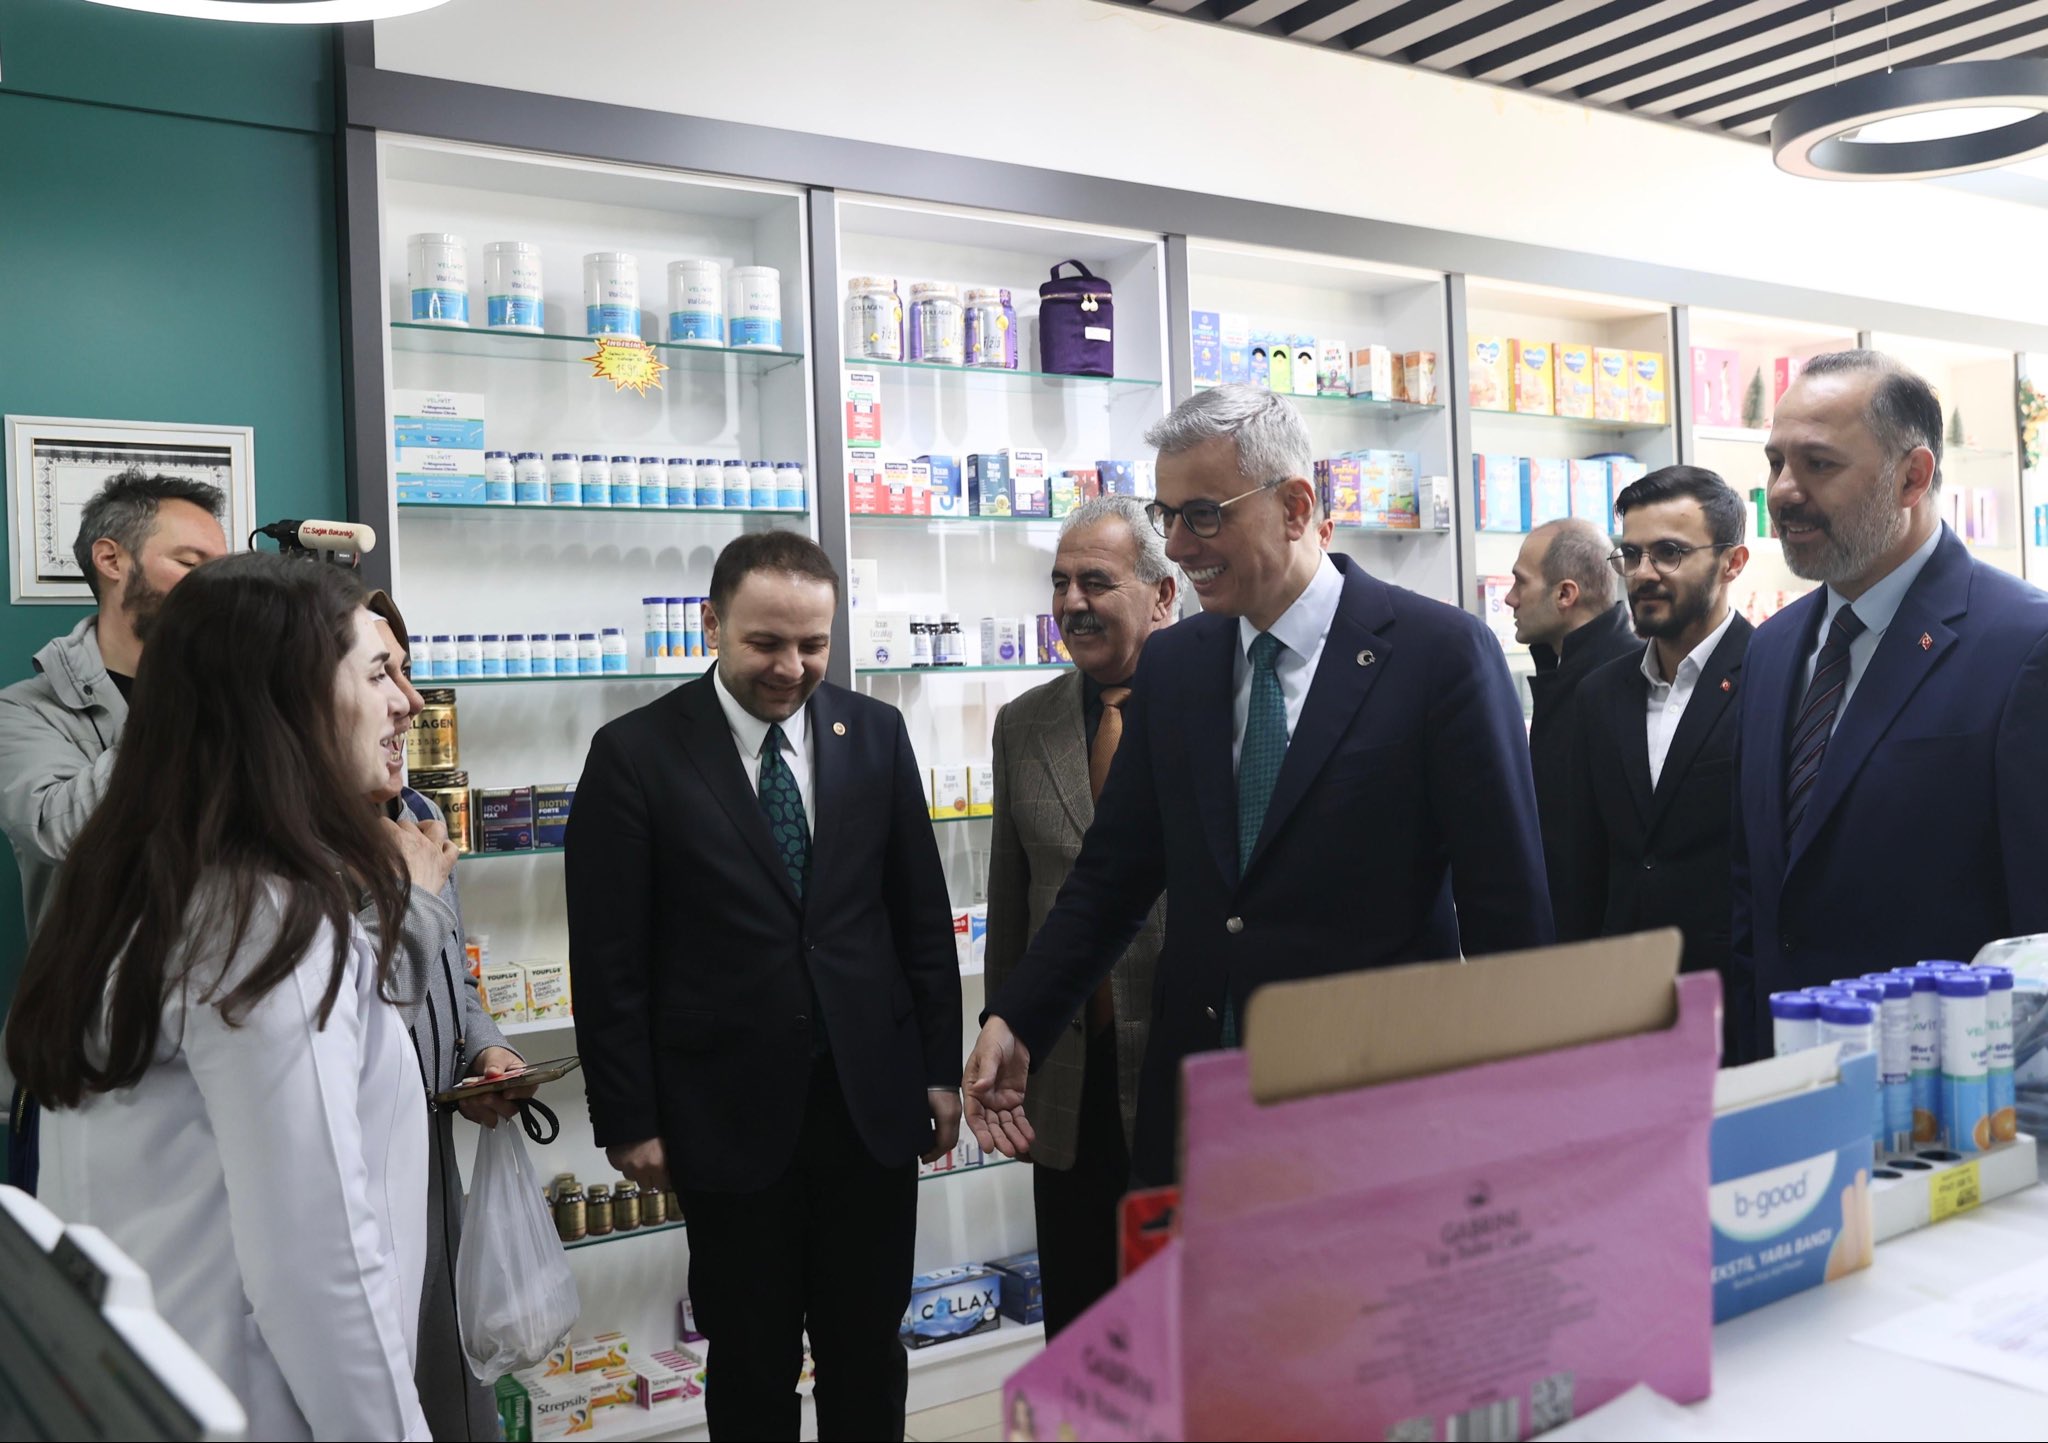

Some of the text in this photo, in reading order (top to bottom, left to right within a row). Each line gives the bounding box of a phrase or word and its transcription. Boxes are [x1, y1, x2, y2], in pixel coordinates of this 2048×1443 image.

[483, 804, 508, 813] IRON
[539, 799, 569, 808] BIOTIN
[487, 973, 517, 981] YOUPLUS
[531, 967, 561, 975] YOUPLUS
[1734, 1170, 1808, 1219] b-good
[1758, 1242, 1793, 1267] YARA
[921, 1289, 994, 1320] COLLAX
[537, 1395, 588, 1415] Strepsils
